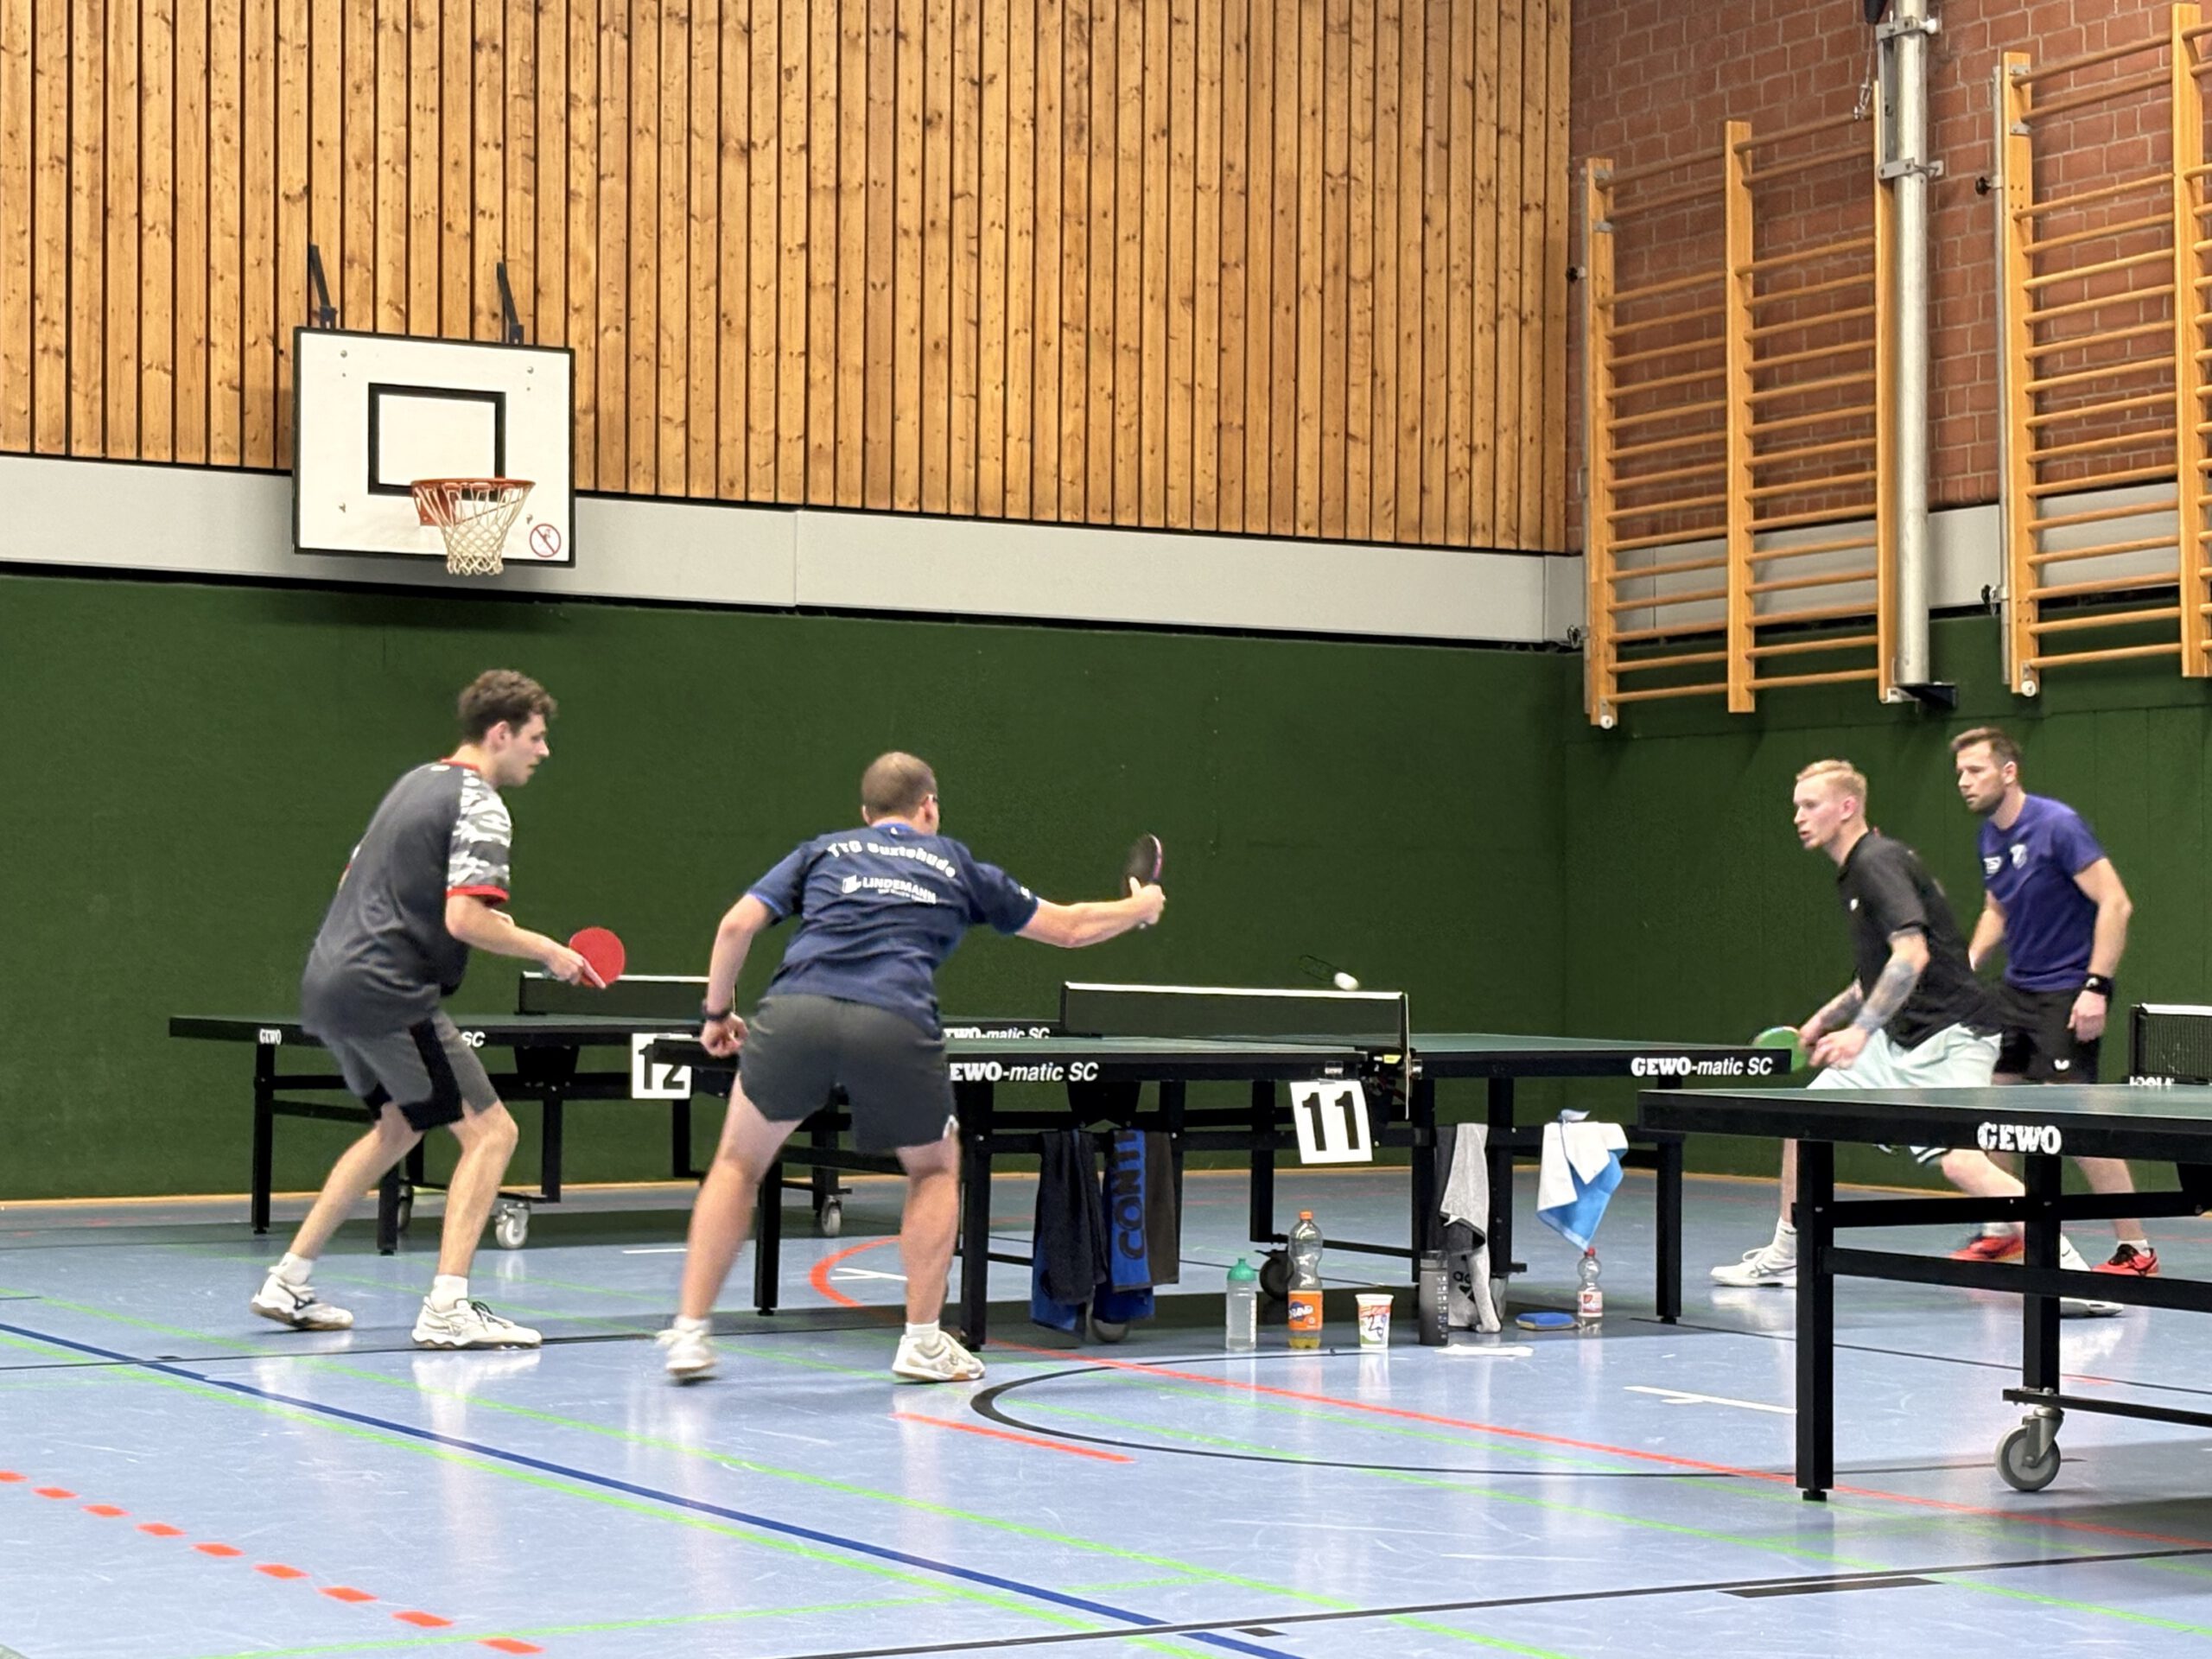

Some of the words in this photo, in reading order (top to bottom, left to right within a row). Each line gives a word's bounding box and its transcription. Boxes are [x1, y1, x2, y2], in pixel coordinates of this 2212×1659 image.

[867, 842, 957, 878] Buxtehude
[862, 876, 937, 904] LINDEMANN
[461, 1030, 486, 1047] SC
[1027, 1027, 1050, 1039] SC
[639, 1043, 685, 1090] 12
[950, 1060, 1065, 1082] EWO-matic
[1068, 1061, 1099, 1082] SC
[1630, 1057, 1744, 1077] GEWO-matic
[1746, 1057, 1773, 1076] SC
[1301, 1090, 1360, 1152] 11
[1977, 1122, 2063, 1155] GEWO
